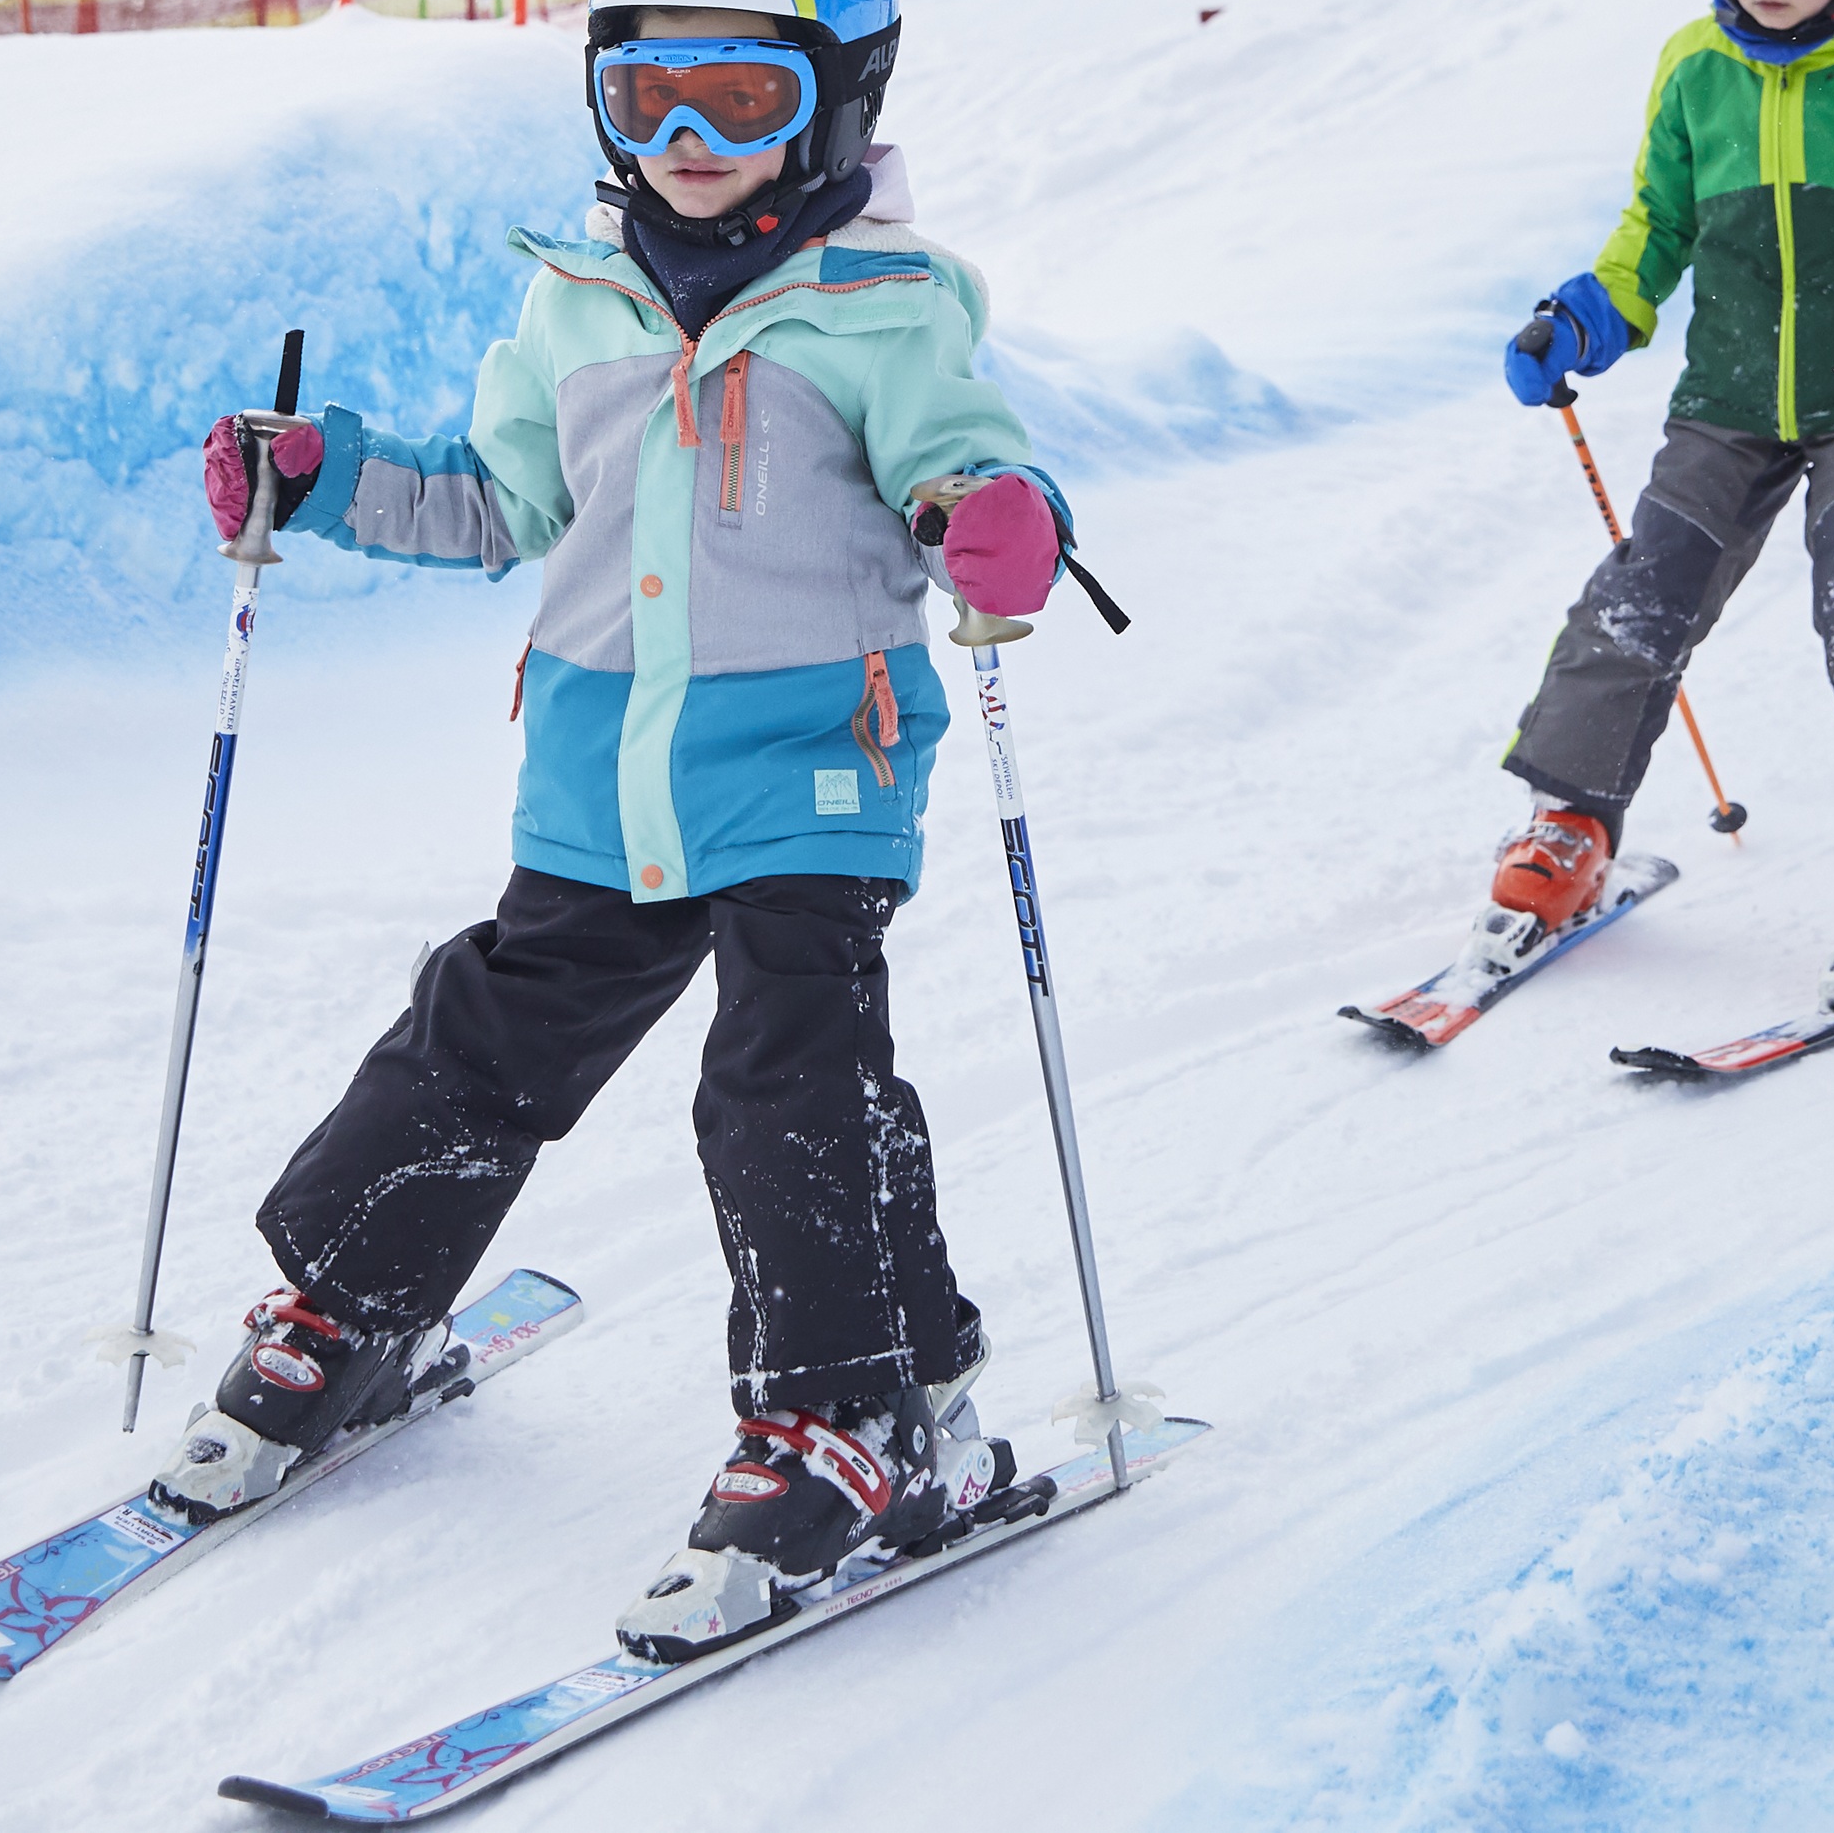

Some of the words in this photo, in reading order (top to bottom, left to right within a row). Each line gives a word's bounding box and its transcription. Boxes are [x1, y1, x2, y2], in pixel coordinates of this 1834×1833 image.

[857, 36, 900, 82] ALP
[755, 439, 771, 516] O'NEILL
[991, 758, 999, 772] SKI
[1000, 817, 1049, 997] SCOTT
